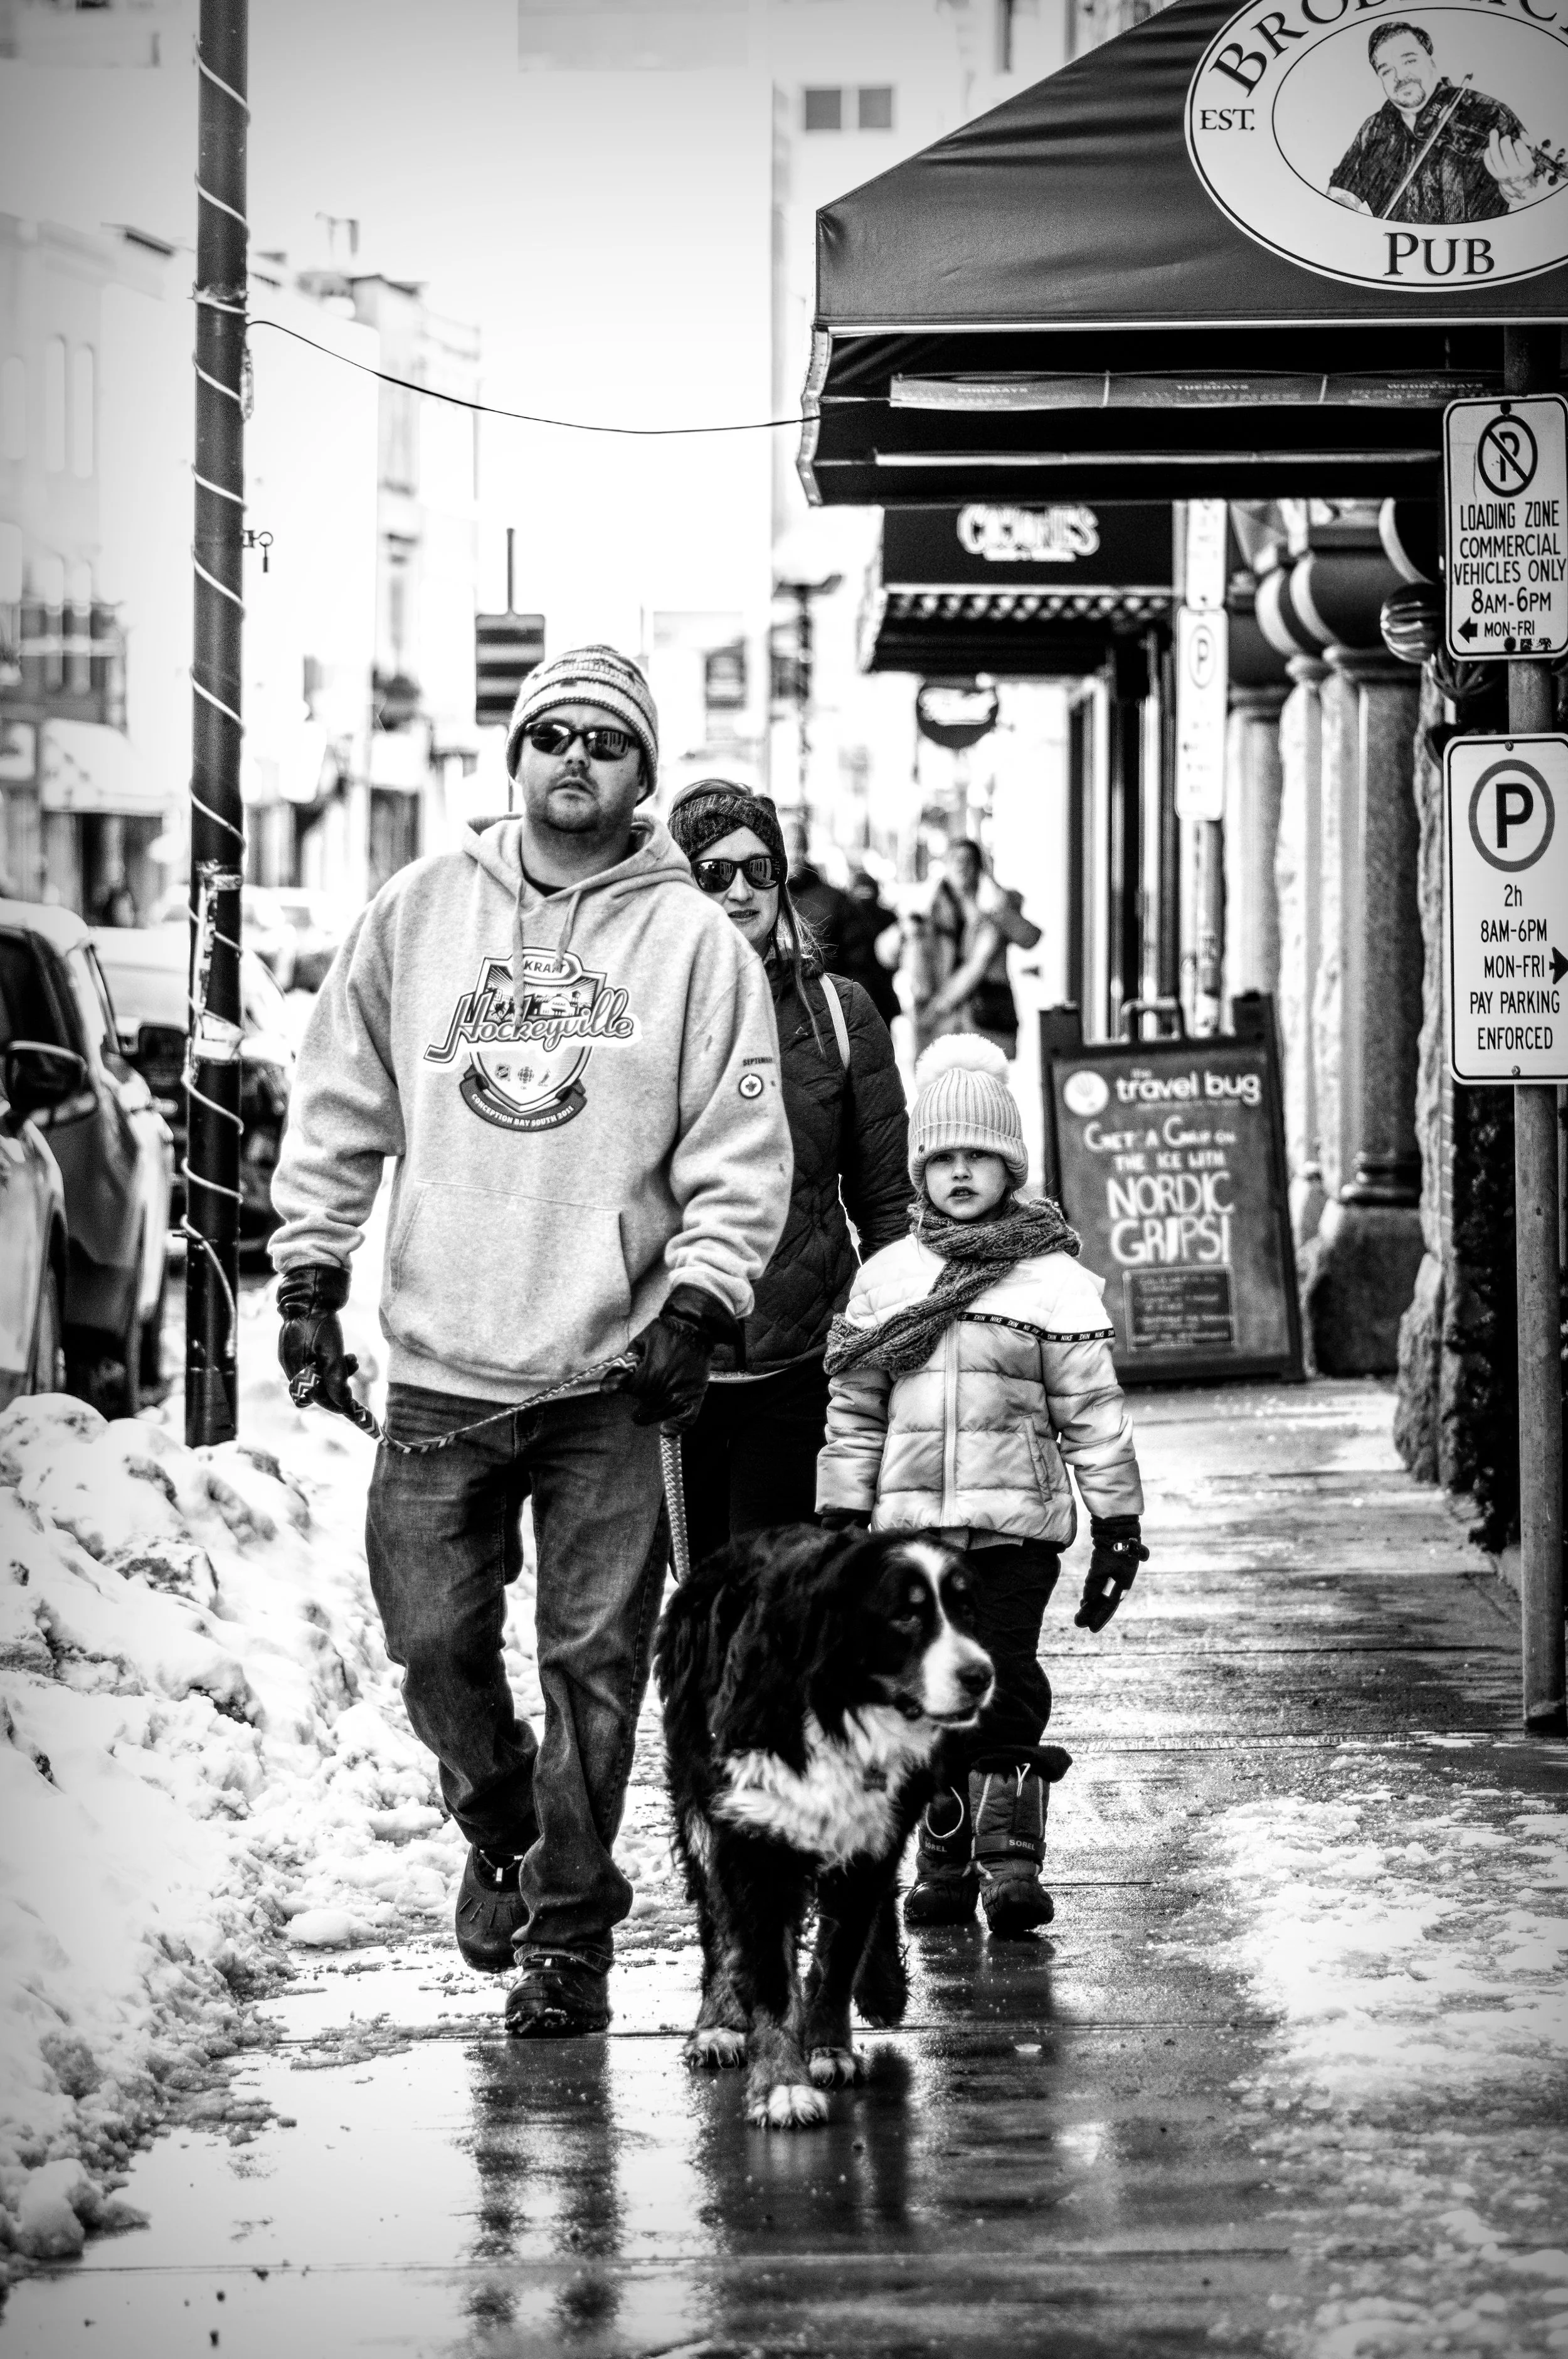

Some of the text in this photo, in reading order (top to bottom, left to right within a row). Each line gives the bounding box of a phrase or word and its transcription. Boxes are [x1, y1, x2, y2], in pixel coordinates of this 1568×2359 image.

[1199, 109, 1256, 131] EST.
[1382, 232, 1495, 276] PUB
[1460, 499, 1560, 531] LOADING ZONE
[1459, 533, 1561, 559] COMMERCIAL
[1454, 558, 1567, 586] VEHICLES ONLY
[1484, 620, 1535, 637] MON-FRI
[1495, 782, 1534, 849] P
[1503, 884, 1523, 907] 2h
[1480, 919, 1547, 943] 8AM-6PM
[1483, 954, 1545, 979] MON-FRI
[1470, 990, 1560, 1014] PAY PARKING
[423, 988, 635, 1063] Hockeyville
[1478, 1026, 1554, 1051] ENFORCED
[1116, 1070, 1262, 1105] travel bug
[471, 1093, 575, 1127] CONCEPTION BAY SOUTH 2011
[1145, 1129, 1158, 1148] A
[1114, 1153, 1146, 1172] THE
[1106, 1171, 1234, 1220] NORDIC
[1009, 1839, 1036, 1851] SOREL
